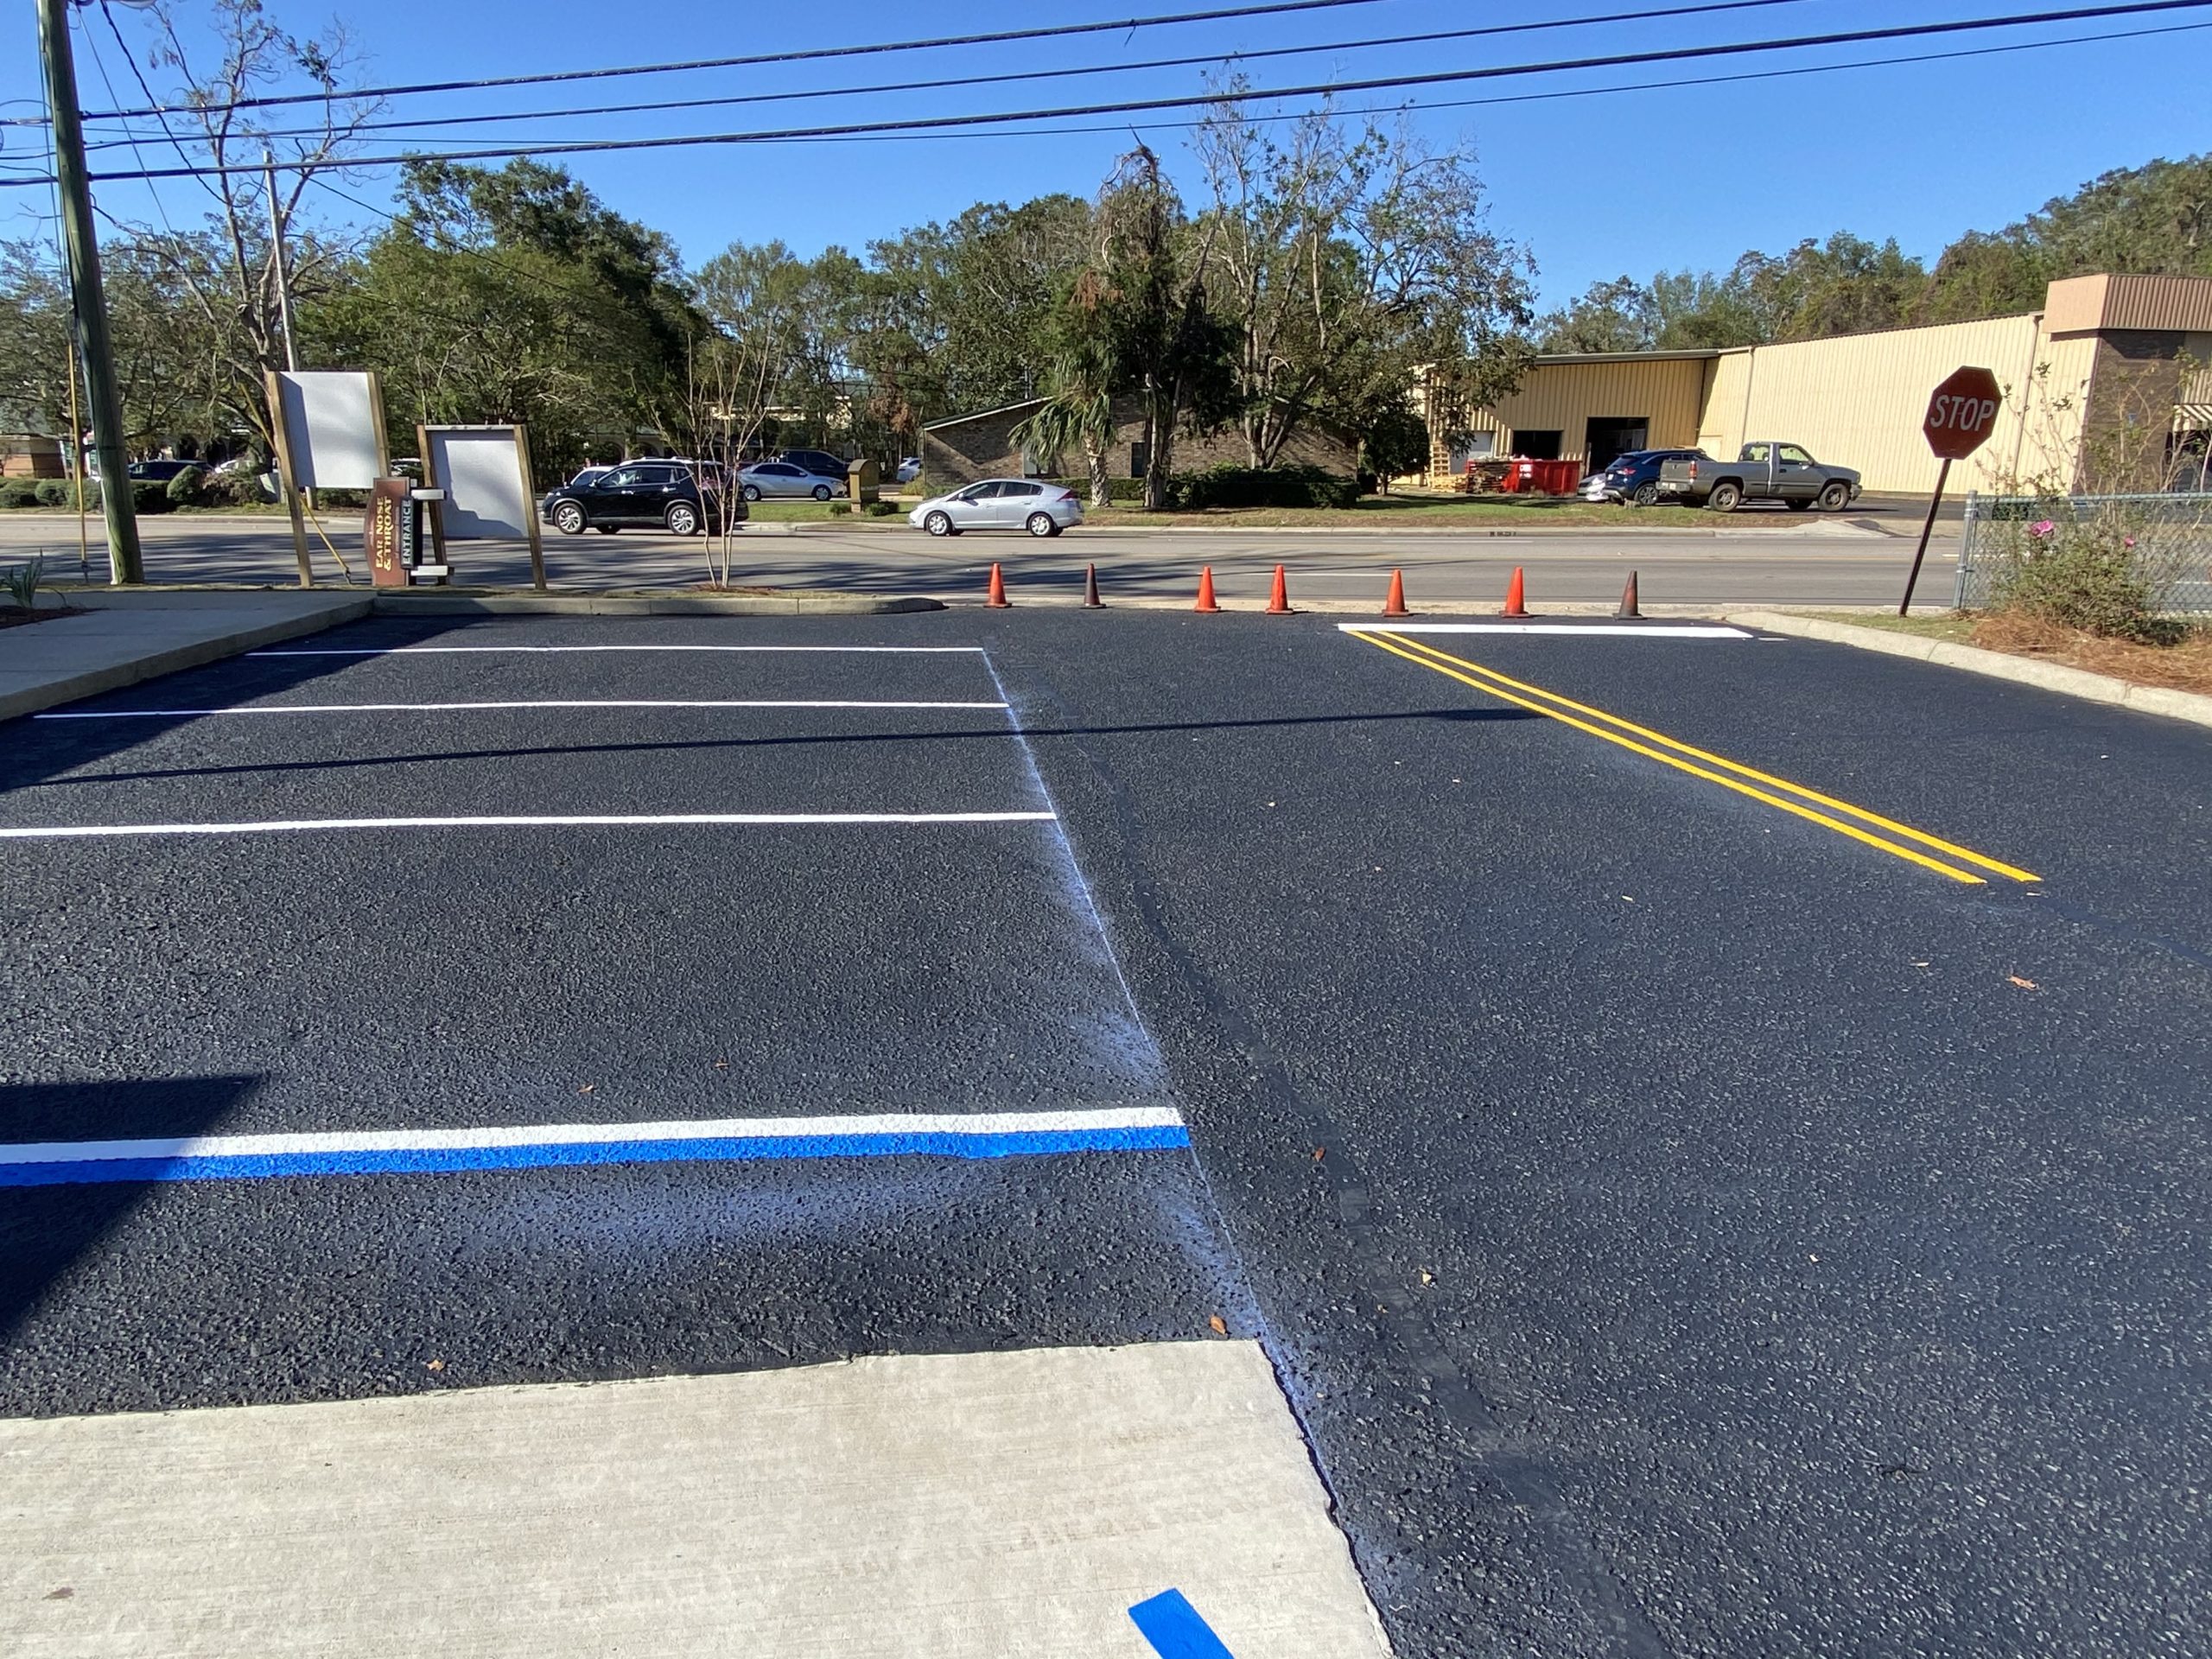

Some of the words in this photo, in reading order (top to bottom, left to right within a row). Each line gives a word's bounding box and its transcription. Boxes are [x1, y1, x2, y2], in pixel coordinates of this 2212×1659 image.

[1930, 395, 1994, 431] STOP
[384, 496, 393, 556] THROAT
[402, 499, 411, 564] ENTRANCE
[384, 558, 391, 571] &
